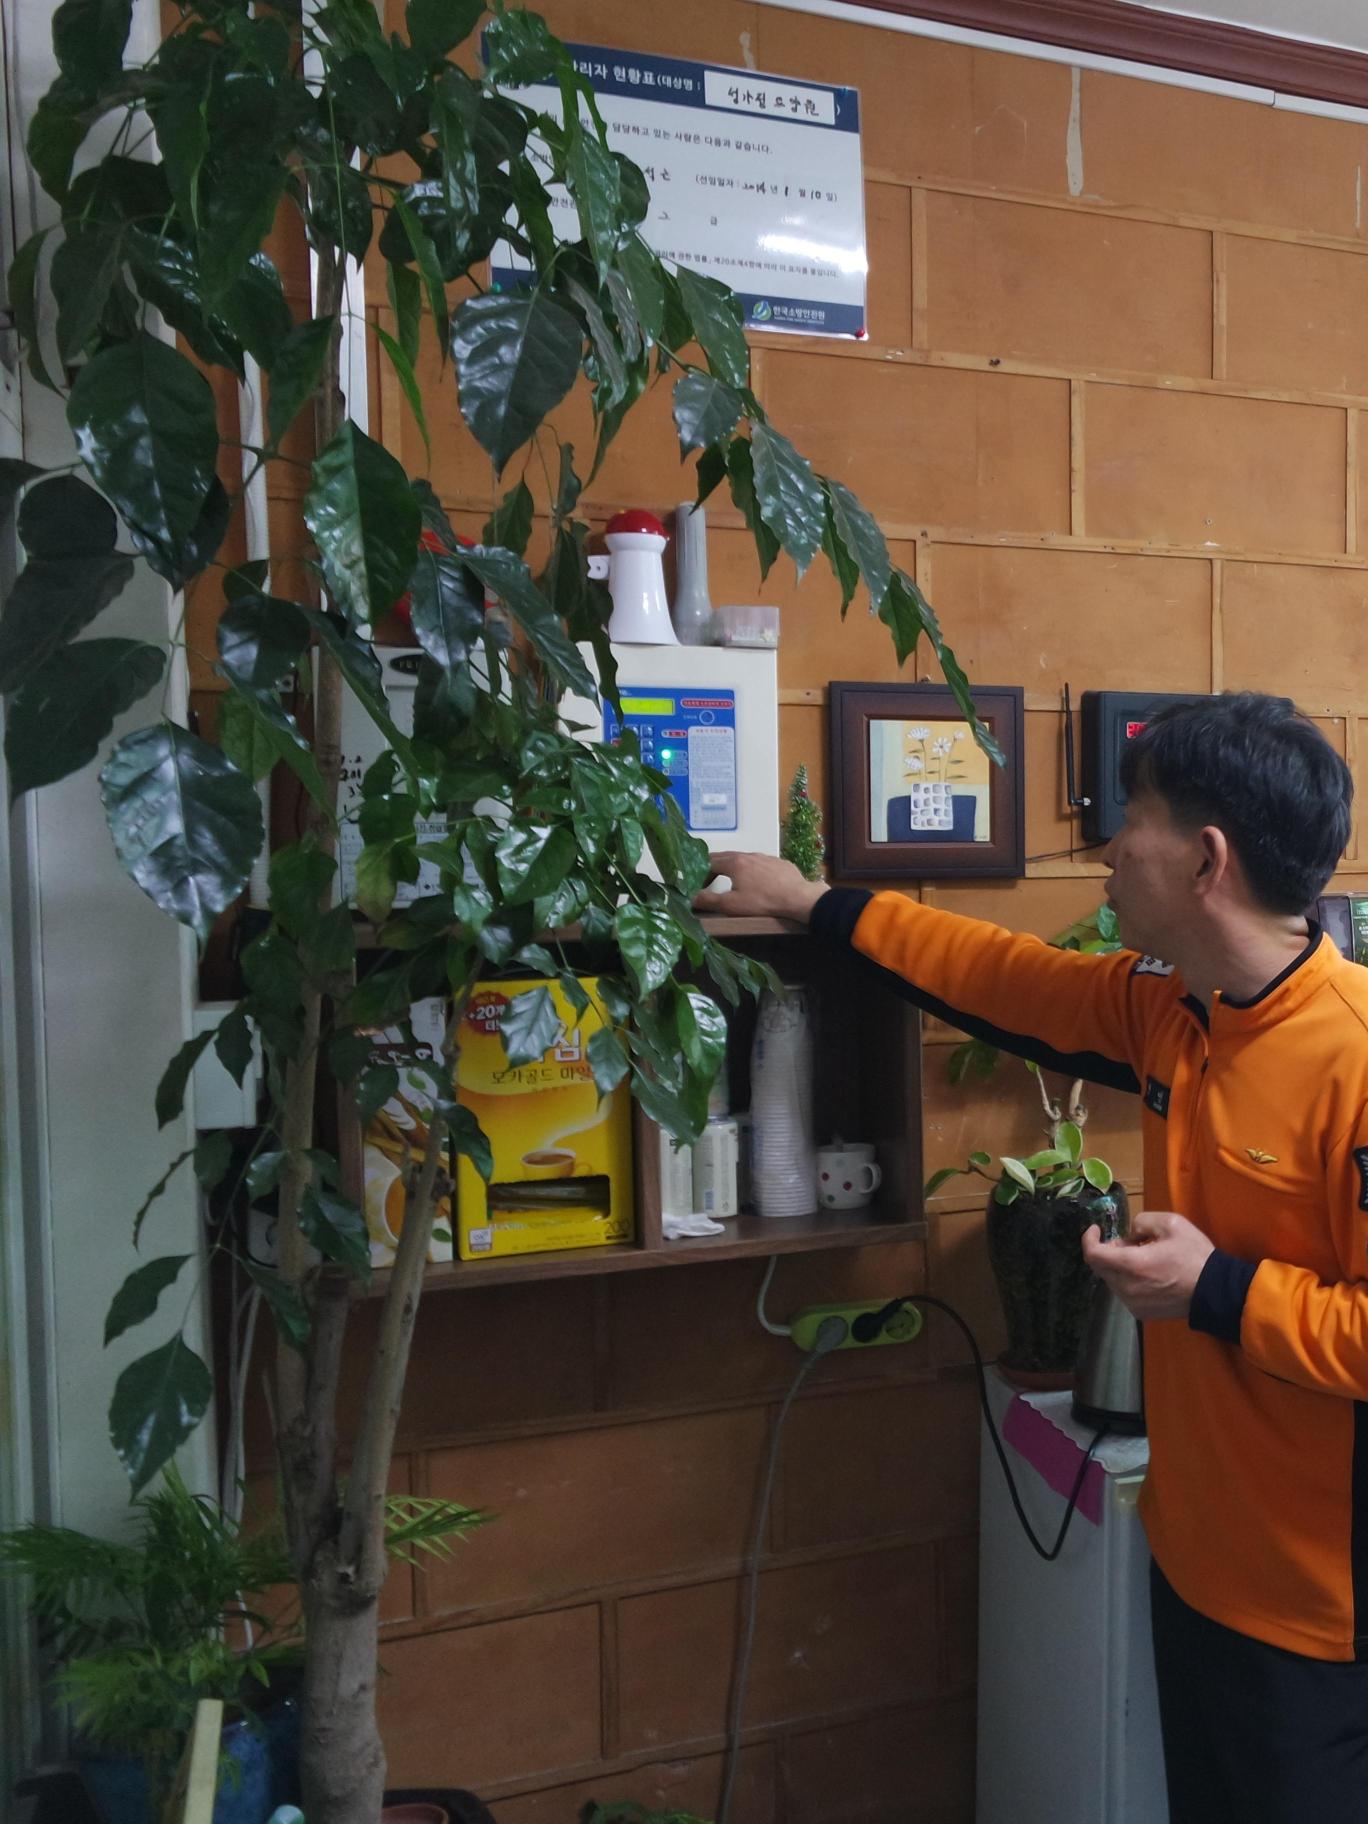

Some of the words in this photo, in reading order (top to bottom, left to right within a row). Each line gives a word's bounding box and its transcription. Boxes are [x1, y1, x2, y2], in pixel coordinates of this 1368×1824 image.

[654, 128, 671, 140] 있는
[675, 132, 701, 145] 사람은
[704, 136, 731, 149] 다음과
[492, 1068, 553, 1085] 모카골드
[560, 1066, 594, 1082] 마일
